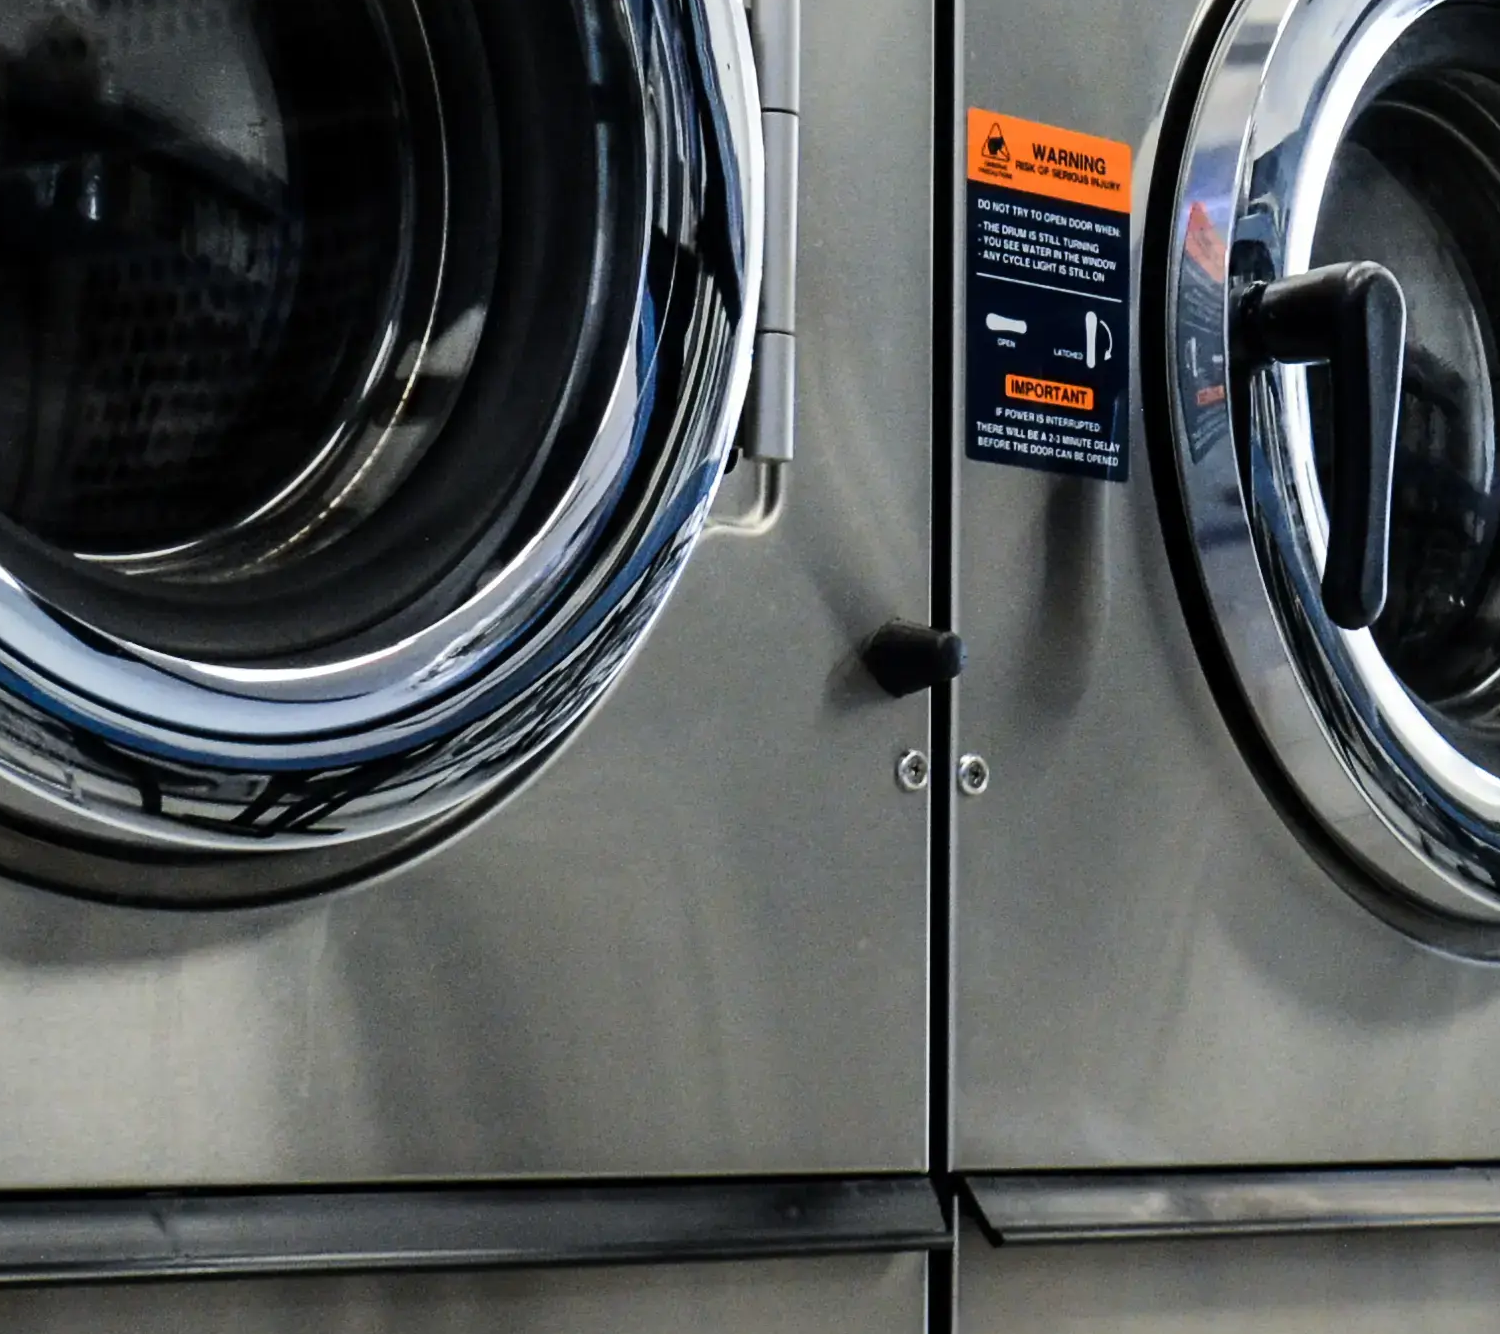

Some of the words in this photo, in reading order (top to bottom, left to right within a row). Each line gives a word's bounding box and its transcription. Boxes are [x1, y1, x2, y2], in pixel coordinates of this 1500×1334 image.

[1032, 143, 1106, 174] WARNING
[1015, 161, 1036, 173] RISK
[1052, 169, 1090, 184] SERIOUS
[1090, 177, 1121, 191] INJURY
[977, 199, 990, 209] DO
[992, 202, 1010, 214] NOT
[1012, 206, 1029, 218] TRY
[1030, 210, 1042, 221] TO
[1043, 214, 1067, 226] OPEN
[1068, 218, 1093, 231] DOOR
[983, 221, 1000, 232] THE
[1001, 225, 1026, 237] DRUM
[1028, 231, 1037, 239] IS
[1038, 233, 1061, 245] STILL
[1063, 238, 1099, 253] TURNING
[983, 236, 1001, 246] YOU
[1003, 240, 1019, 251] SEE
[1021, 244, 1051, 256] WATER
[1053, 250, 1062, 259] IN
[1064, 252, 1079, 263] THE
[1081, 256, 1116, 270] WINDOW
[983, 250, 1000, 261] ANY
[1002, 254, 1030, 267] CYCLE
[1032, 260, 1057, 272] LIGHT
[1058, 265, 1067, 274] IS
[1068, 267, 1090, 279] STILL
[1092, 272, 1105, 282] ON
[997, 338, 1016, 347] OPEN
[1053, 348, 1084, 359] LATCHED
[1011, 379, 1087, 404] IMPORTANT
[995, 408, 1004, 416] IF
[1004, 409, 1035, 421] POWER
[1036, 414, 1045, 423] IS
[976, 422, 1004, 434] THERE
[1006, 426, 1026, 437] WILL
[1027, 430, 1039, 440] BE
[1062, 436, 1092, 448] MINUTE
[1094, 440, 1120, 452] DELAY
[977, 437, 1011, 450] BEFORE
[1013, 442, 1028, 452] THE
[1030, 445, 1054, 456] DOOR
[1055, 450, 1073, 459] CAN
[1074, 452, 1084, 460] BE
[1086, 454, 1119, 466] OPENED
